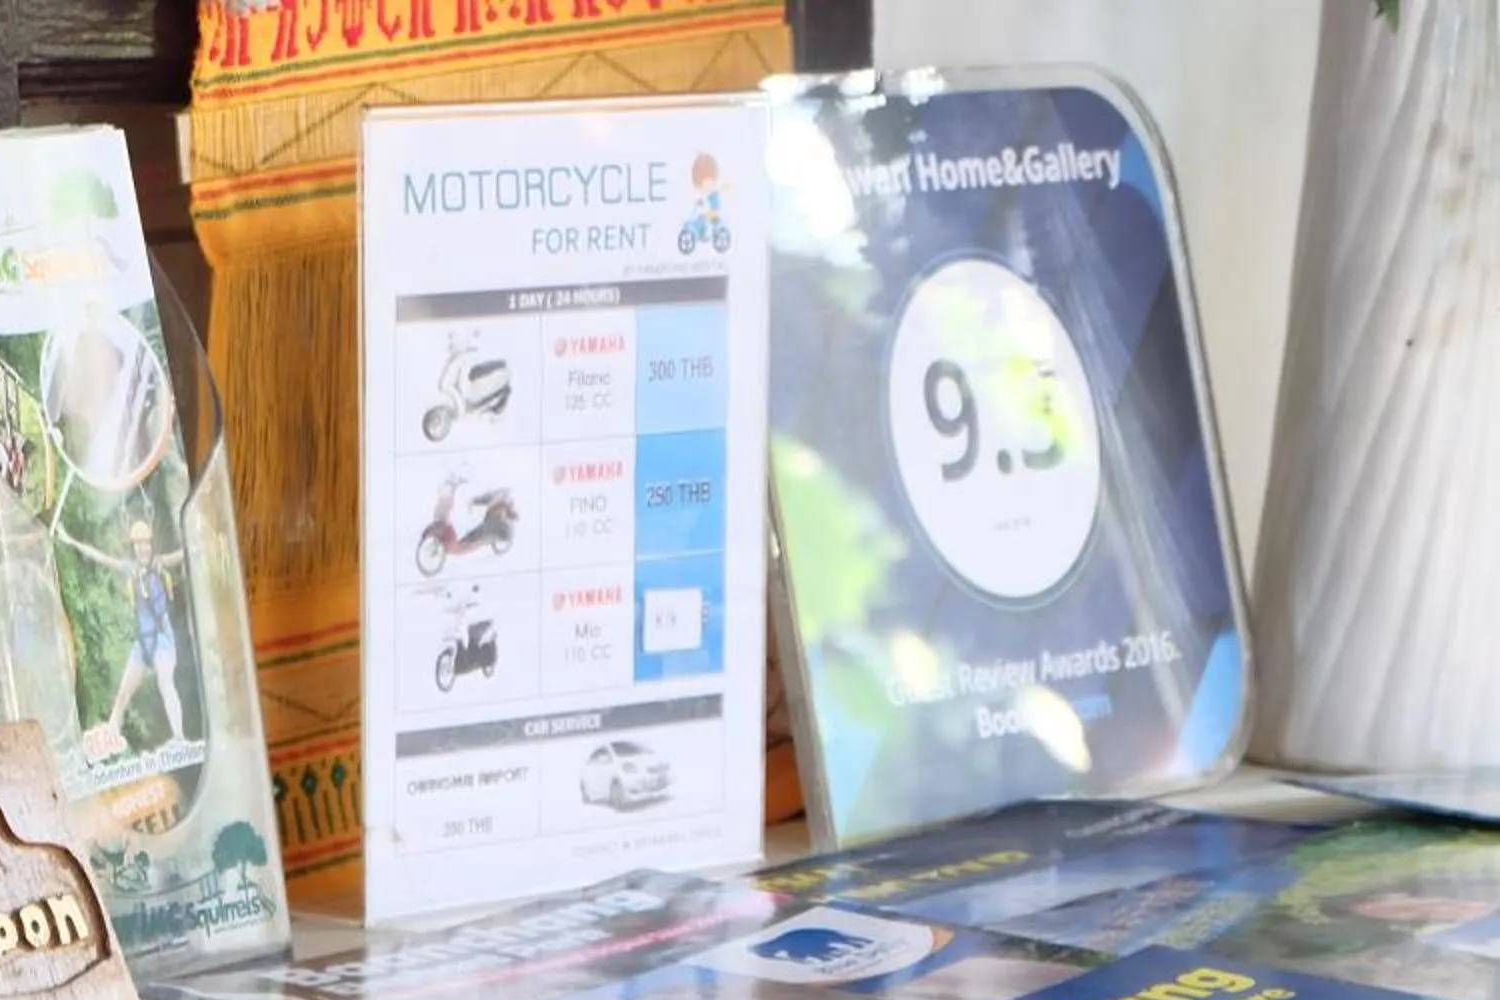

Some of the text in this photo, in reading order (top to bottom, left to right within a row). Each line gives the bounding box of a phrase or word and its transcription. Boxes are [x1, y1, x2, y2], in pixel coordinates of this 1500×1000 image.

[915, 143, 1121, 192] Home&Gallery
[403, 162, 668, 215] MOTORCYCLE
[531, 223, 652, 255] FOR RENT
[518, 293, 544, 309] DAY
[570, 335, 626, 356] YAMAHA
[648, 355, 714, 382] 300 THB
[569, 460, 624, 481] YAMAHA
[646, 480, 712, 508] 250 THB
[569, 585, 623, 609] YAMAHA
[958, 657, 1037, 694] Review
[1041, 640, 1121, 682] Awards
